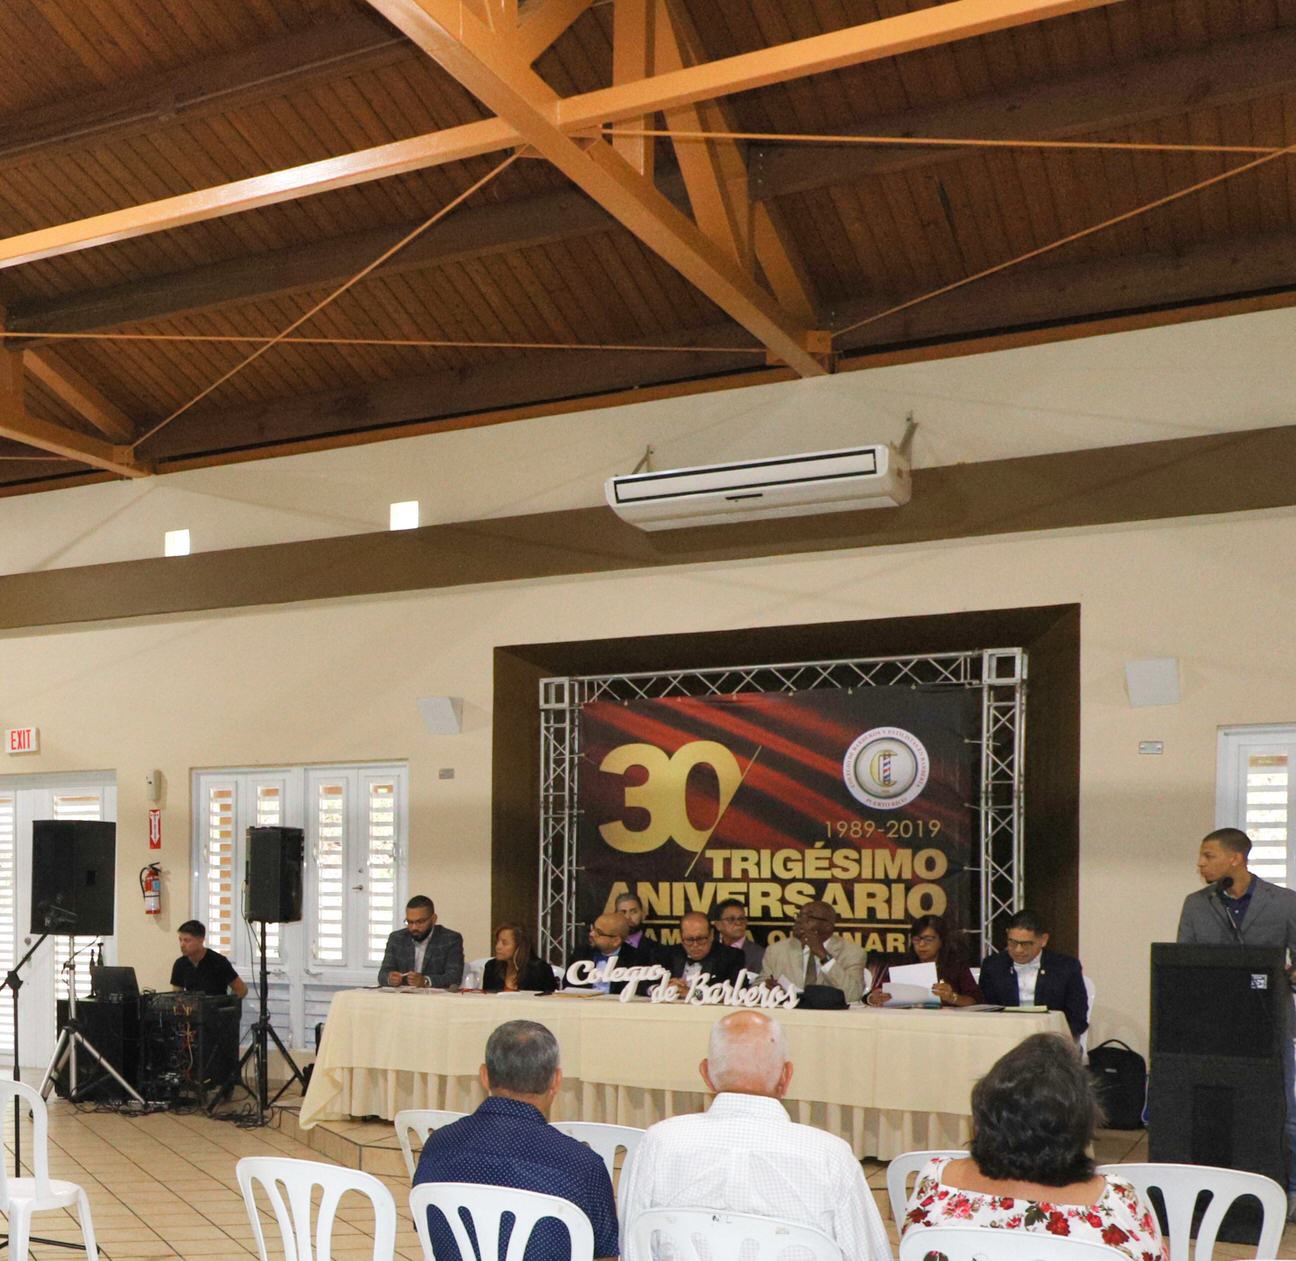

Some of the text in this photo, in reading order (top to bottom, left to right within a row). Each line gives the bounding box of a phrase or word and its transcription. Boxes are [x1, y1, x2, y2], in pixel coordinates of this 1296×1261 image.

[11, 729, 31, 750] EXIT
[825, 820, 941, 839] 1989-2019
[705, 841, 948, 880] TRIGÉSIMO
[648, 968, 801, 1009] de Barberos
